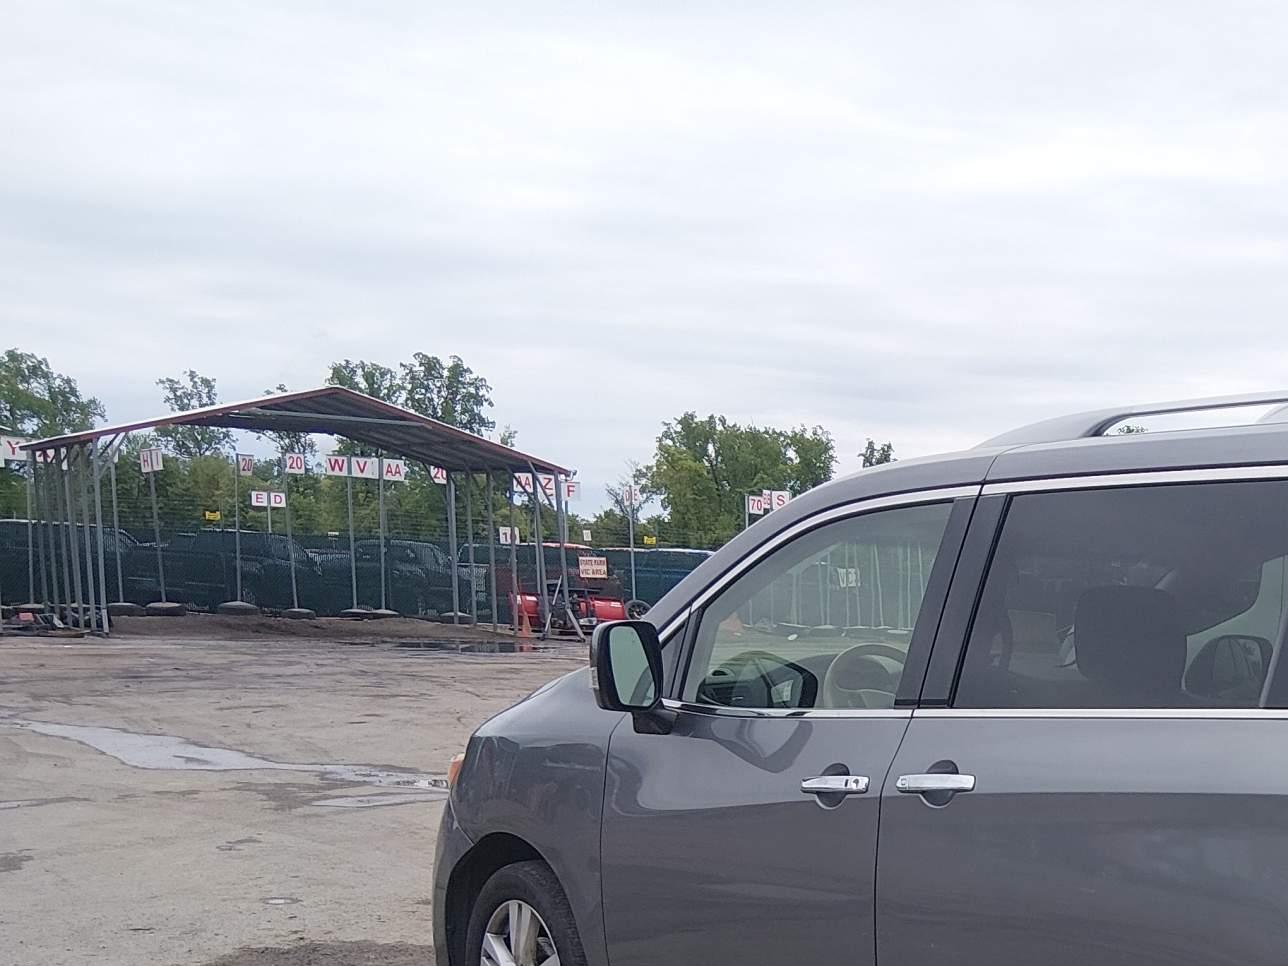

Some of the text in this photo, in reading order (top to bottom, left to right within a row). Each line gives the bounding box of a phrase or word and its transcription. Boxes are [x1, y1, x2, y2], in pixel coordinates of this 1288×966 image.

[241, 458, 252, 472] 20
[288, 455, 303, 470] 20
[328, 458, 345, 473] W
[356, 460, 368, 474] V
[385, 463, 402, 477] AA
[567, 484, 576, 498] F
[255, 494, 283, 505] E D
[750, 499, 763, 512] 70
[776, 494, 786, 507] S
